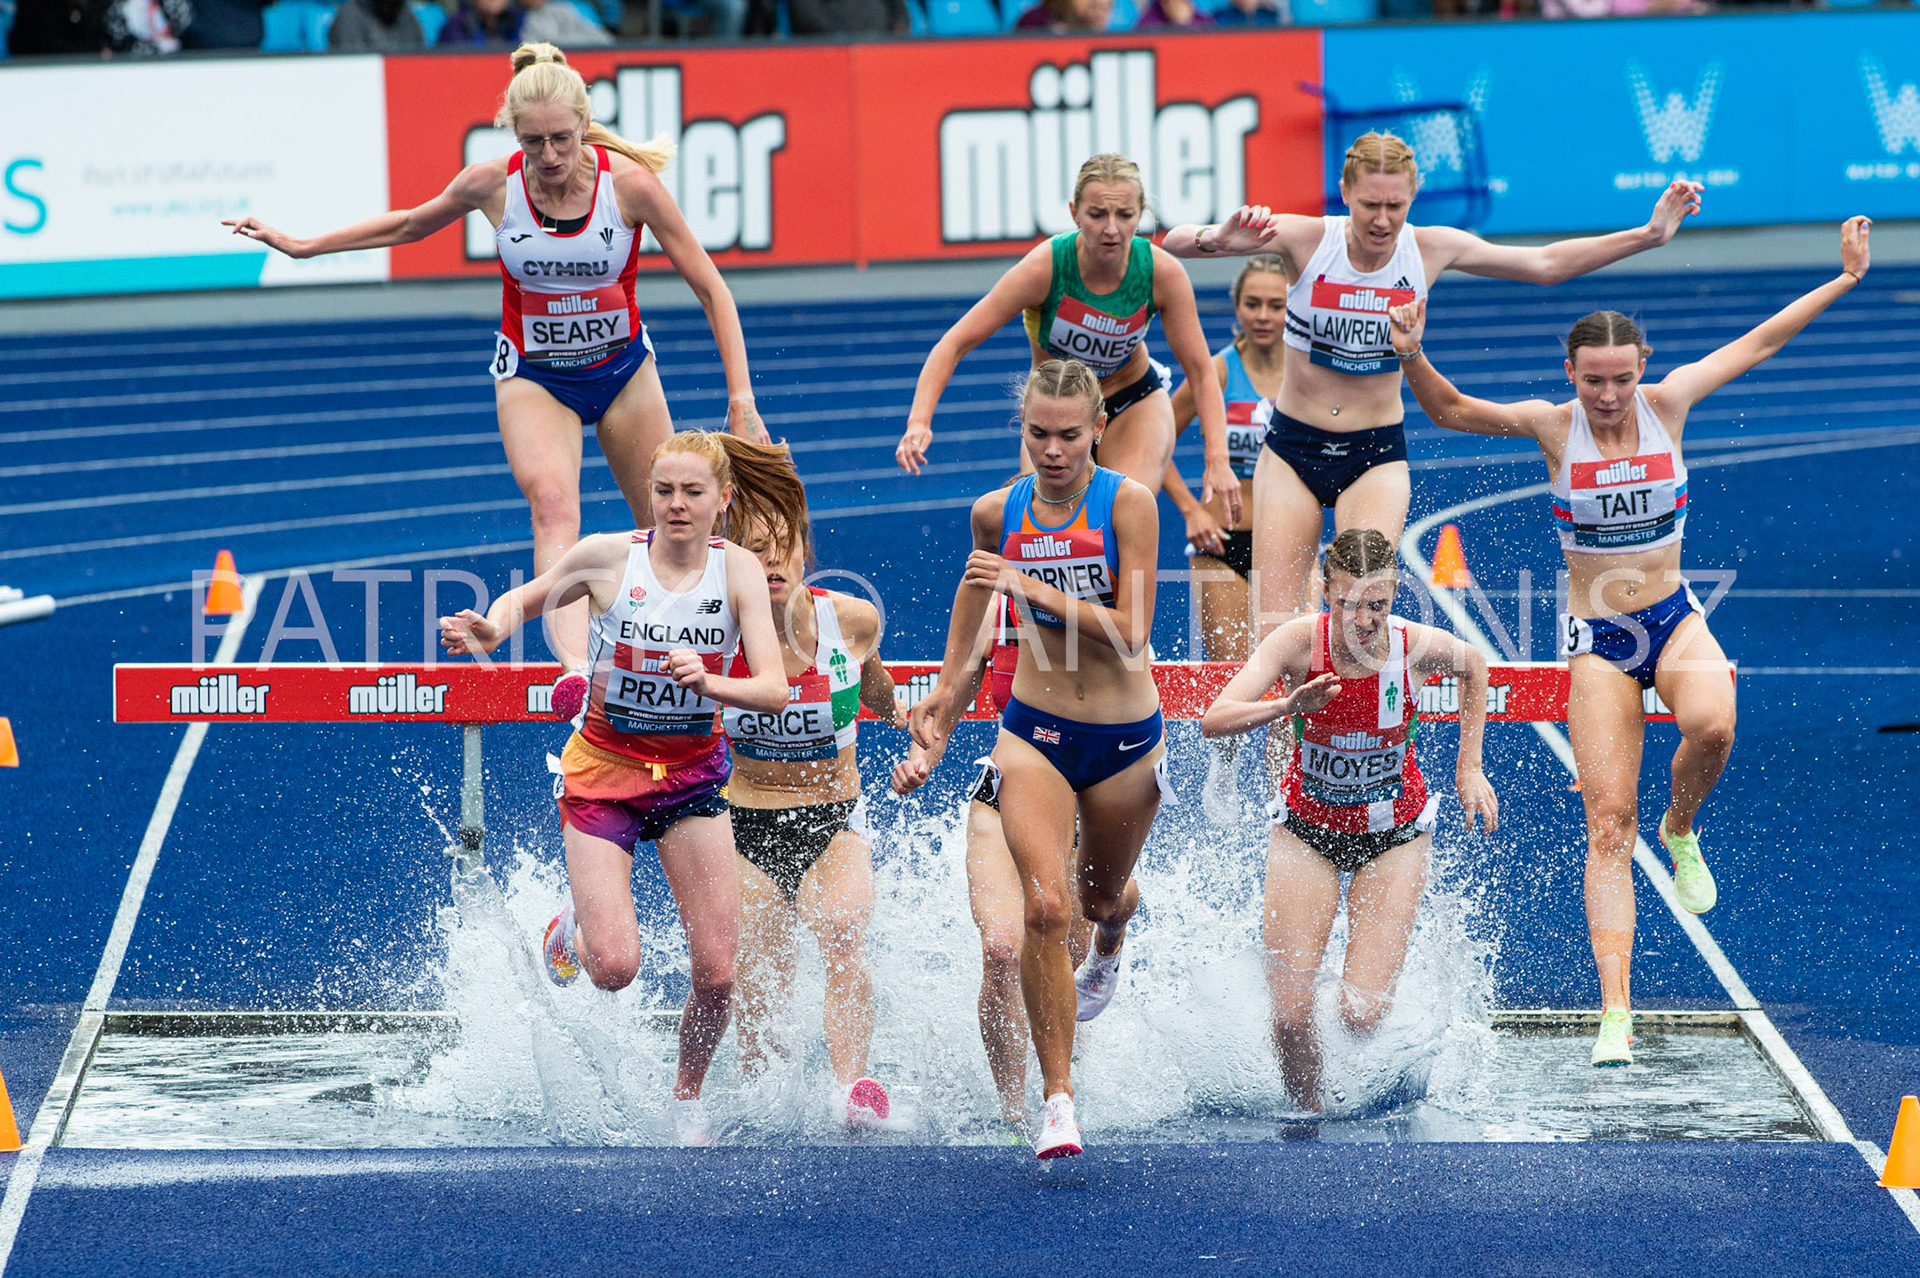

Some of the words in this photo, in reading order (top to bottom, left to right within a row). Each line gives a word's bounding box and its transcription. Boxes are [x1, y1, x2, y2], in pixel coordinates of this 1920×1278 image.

[940, 49, 1258, 242] müller
[5, 159, 46, 234] S
[523, 260, 609, 277] CYMRU
[547, 295, 598, 315] müller
[1339, 289, 1391, 312] müller
[532, 315, 620, 345] SEARY
[1081, 312, 1131, 335] müller
[497, 339, 509, 375] 8
[1058, 329, 1139, 359] JONES
[551, 352, 608, 368] MANCHESTER
[1331, 357, 1381, 372] MANCHESTER
[1595, 460, 1648, 486] müller
[1596, 489, 1652, 519] TAIT
[1020, 535, 1073, 559] müller
[1598, 529, 1657, 544] MANCHESTER
[1022, 563, 1107, 593] ORNER
[620, 620, 725, 645] ENGLAND
[1568, 615, 1579, 652] 9
[170, 673, 271, 714] müller
[349, 673, 449, 714] müller
[628, 721, 689, 731] MANCHESTER
[737, 709, 821, 736] GRICE
[755, 748, 813, 759] MANCHESTER
[1330, 731, 1384, 750] müller
[1309, 748, 1399, 780] MOYES
